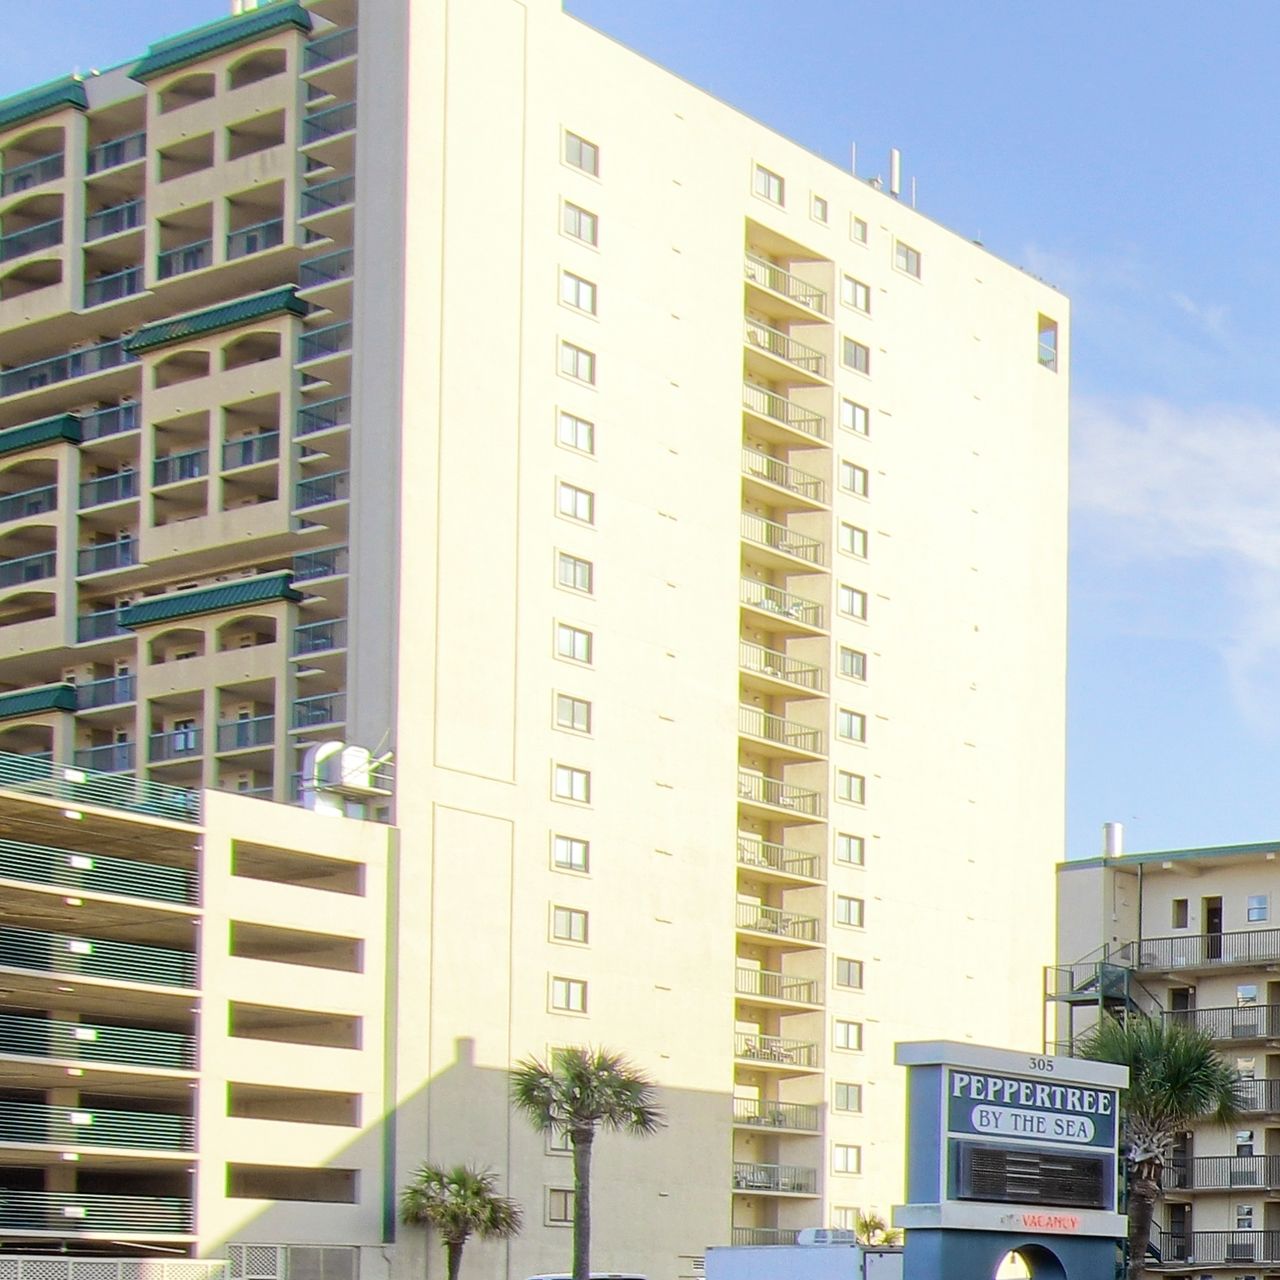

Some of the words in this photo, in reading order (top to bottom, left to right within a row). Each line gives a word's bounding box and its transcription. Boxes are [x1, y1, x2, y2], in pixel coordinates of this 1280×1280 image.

[1028, 1057, 1054, 1072] 305
[952, 1072, 1112, 1115] PEPPERTREE
[979, 1109, 1002, 1129] BY
[1010, 1113, 1047, 1134] THE
[1053, 1118, 1089, 1139] SEA
[1022, 1214, 1078, 1230] VACANCY
